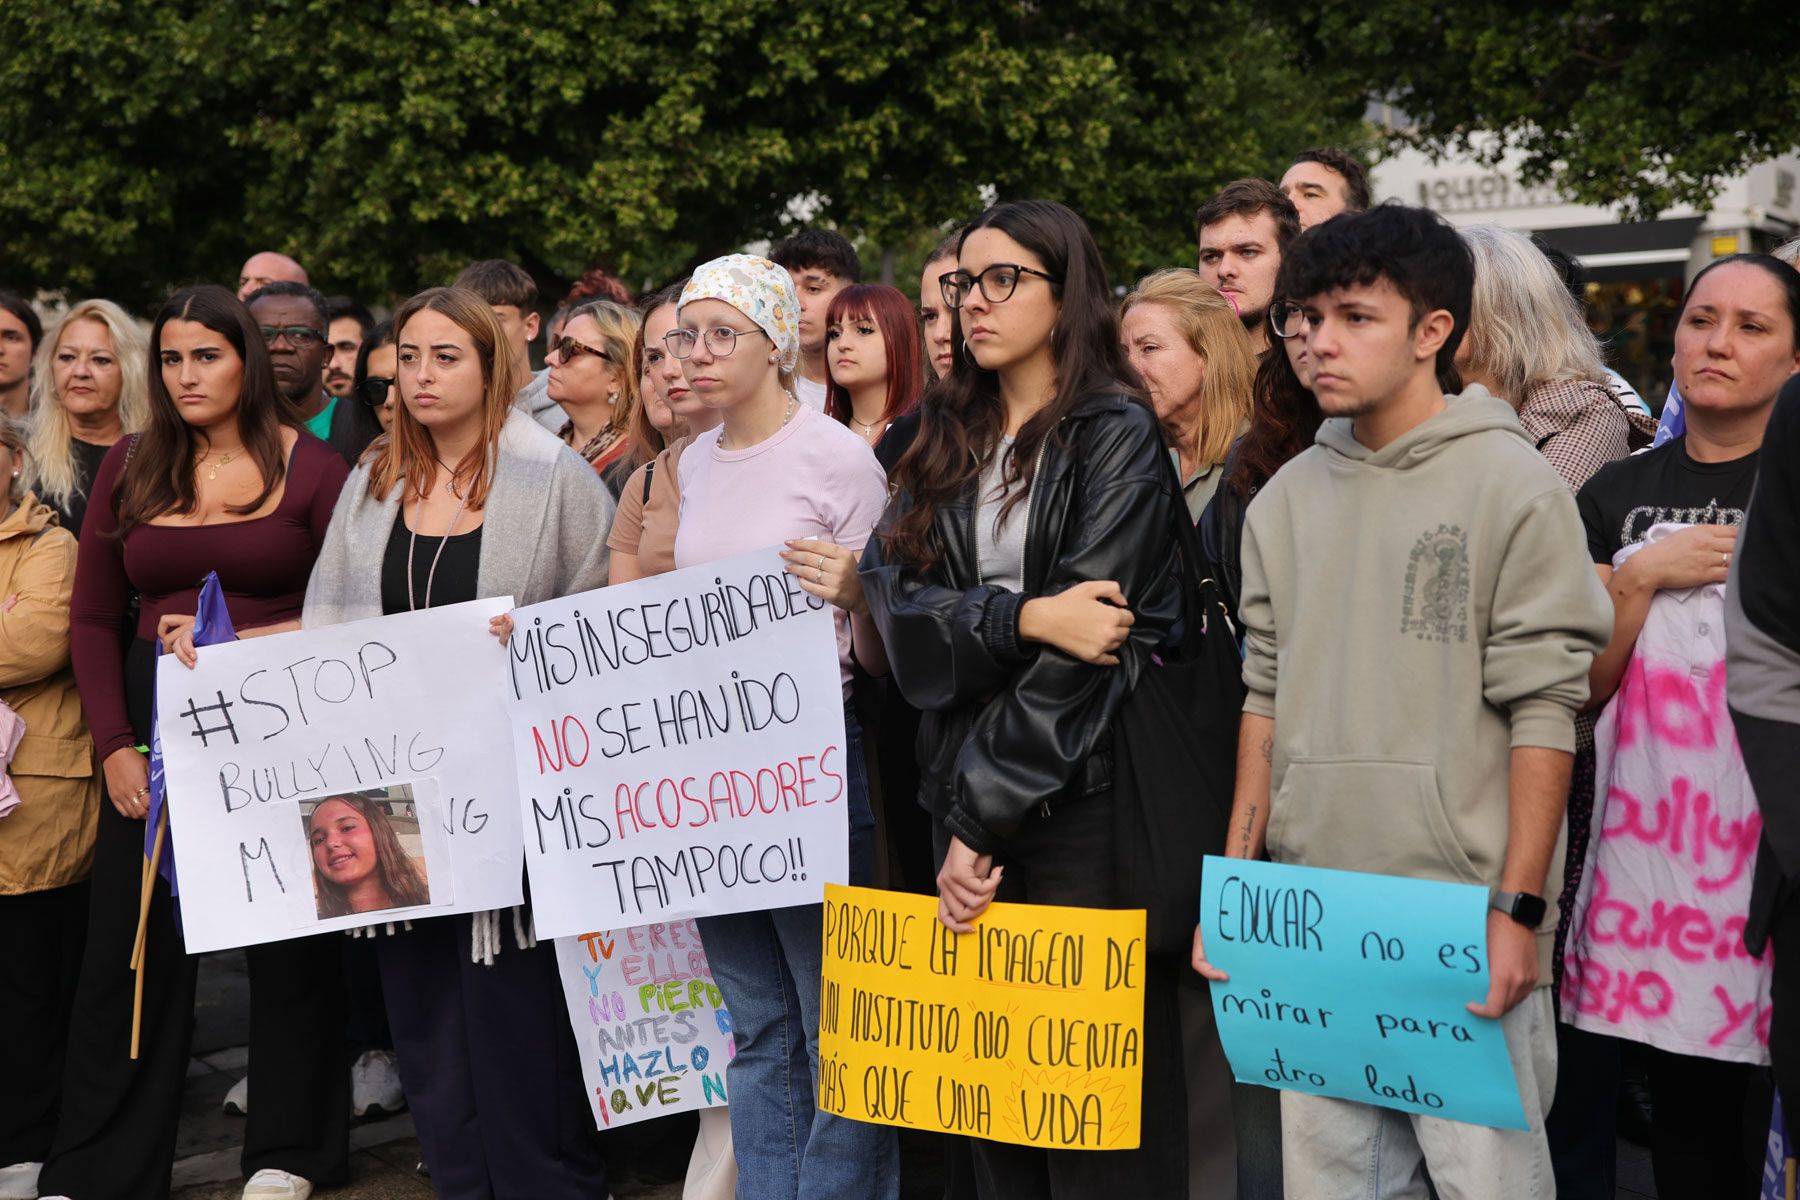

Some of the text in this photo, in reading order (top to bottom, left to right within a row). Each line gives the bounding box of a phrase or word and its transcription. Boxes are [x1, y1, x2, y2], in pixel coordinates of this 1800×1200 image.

[180, 641, 397, 747] #STOP
[532, 715, 589, 775] NO
[596, 702, 650, 758] SE
[654, 685, 730, 748] HAN
[219, 732, 444, 813] BULLYING
[615, 745, 843, 839] ACOSADORES
[592, 837, 807, 914] TAMPOCO!!
[826, 899, 1141, 992] PORQUE LA IMAGEN DE
[1218, 876, 1481, 974] EDUCAR no es
[582, 962, 602, 998] Y
[588, 991, 626, 1026] NO
[1222, 988, 1475, 1043] mirar para
[598, 1009, 699, 1056] ANTES
[820, 975, 1138, 1072] UN INSTITUTO NO CUENTA
[598, 1045, 709, 1087] HAZLO
[864, 1065, 914, 1124] QUE
[936, 1075, 992, 1136] UNA
[1021, 1090, 1102, 1146] VIDA
[1264, 1048, 1444, 1109] otro lado
